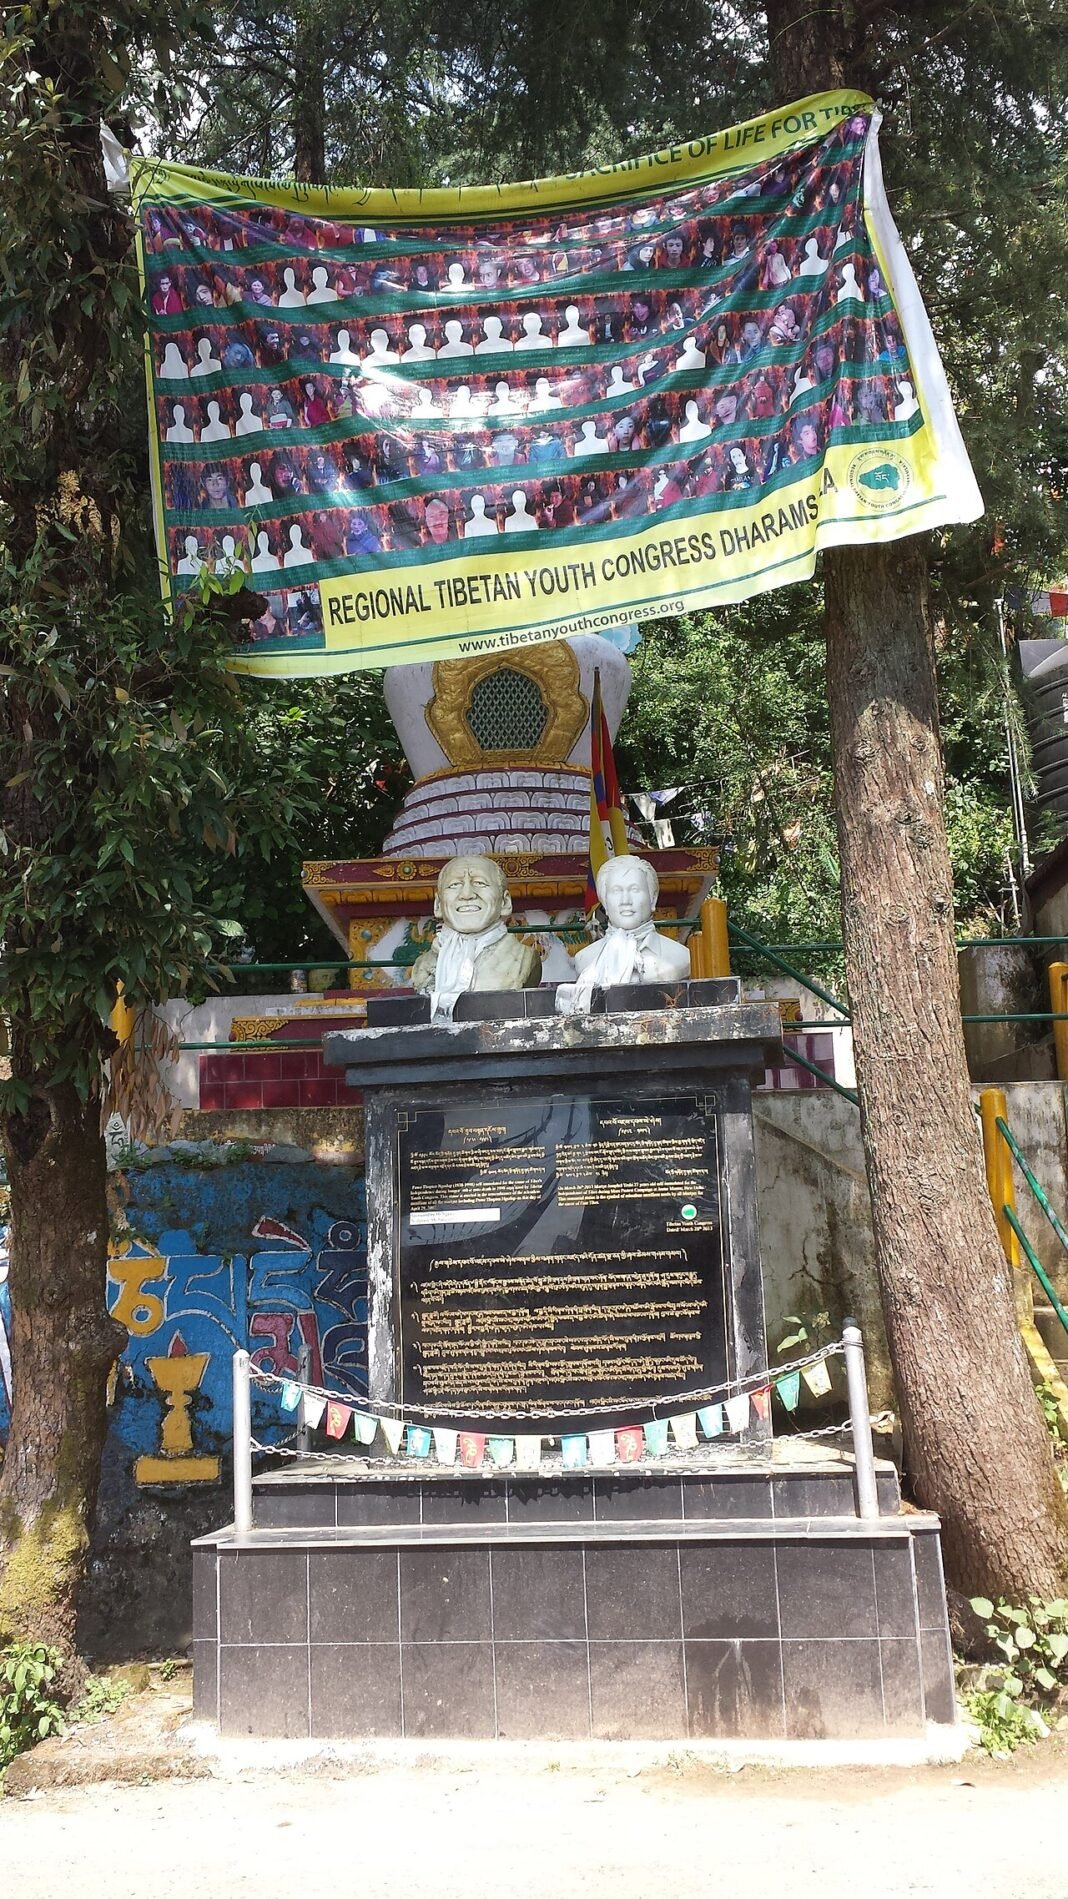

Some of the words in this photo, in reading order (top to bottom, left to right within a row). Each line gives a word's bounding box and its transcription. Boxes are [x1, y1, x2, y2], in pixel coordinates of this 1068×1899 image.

[688, 139, 717, 158] OF
[723, 124, 766, 151] LIFE
[771, 111, 817, 139] FOR
[328, 584, 431, 626] REGIONAL
[433, 572, 521, 608] TIBETAN
[523, 562, 597, 597] YOUTH
[601, 533, 716, 581] CONGRESS
[459, 600, 685, 652] www.tibetanyouthcongress.org
